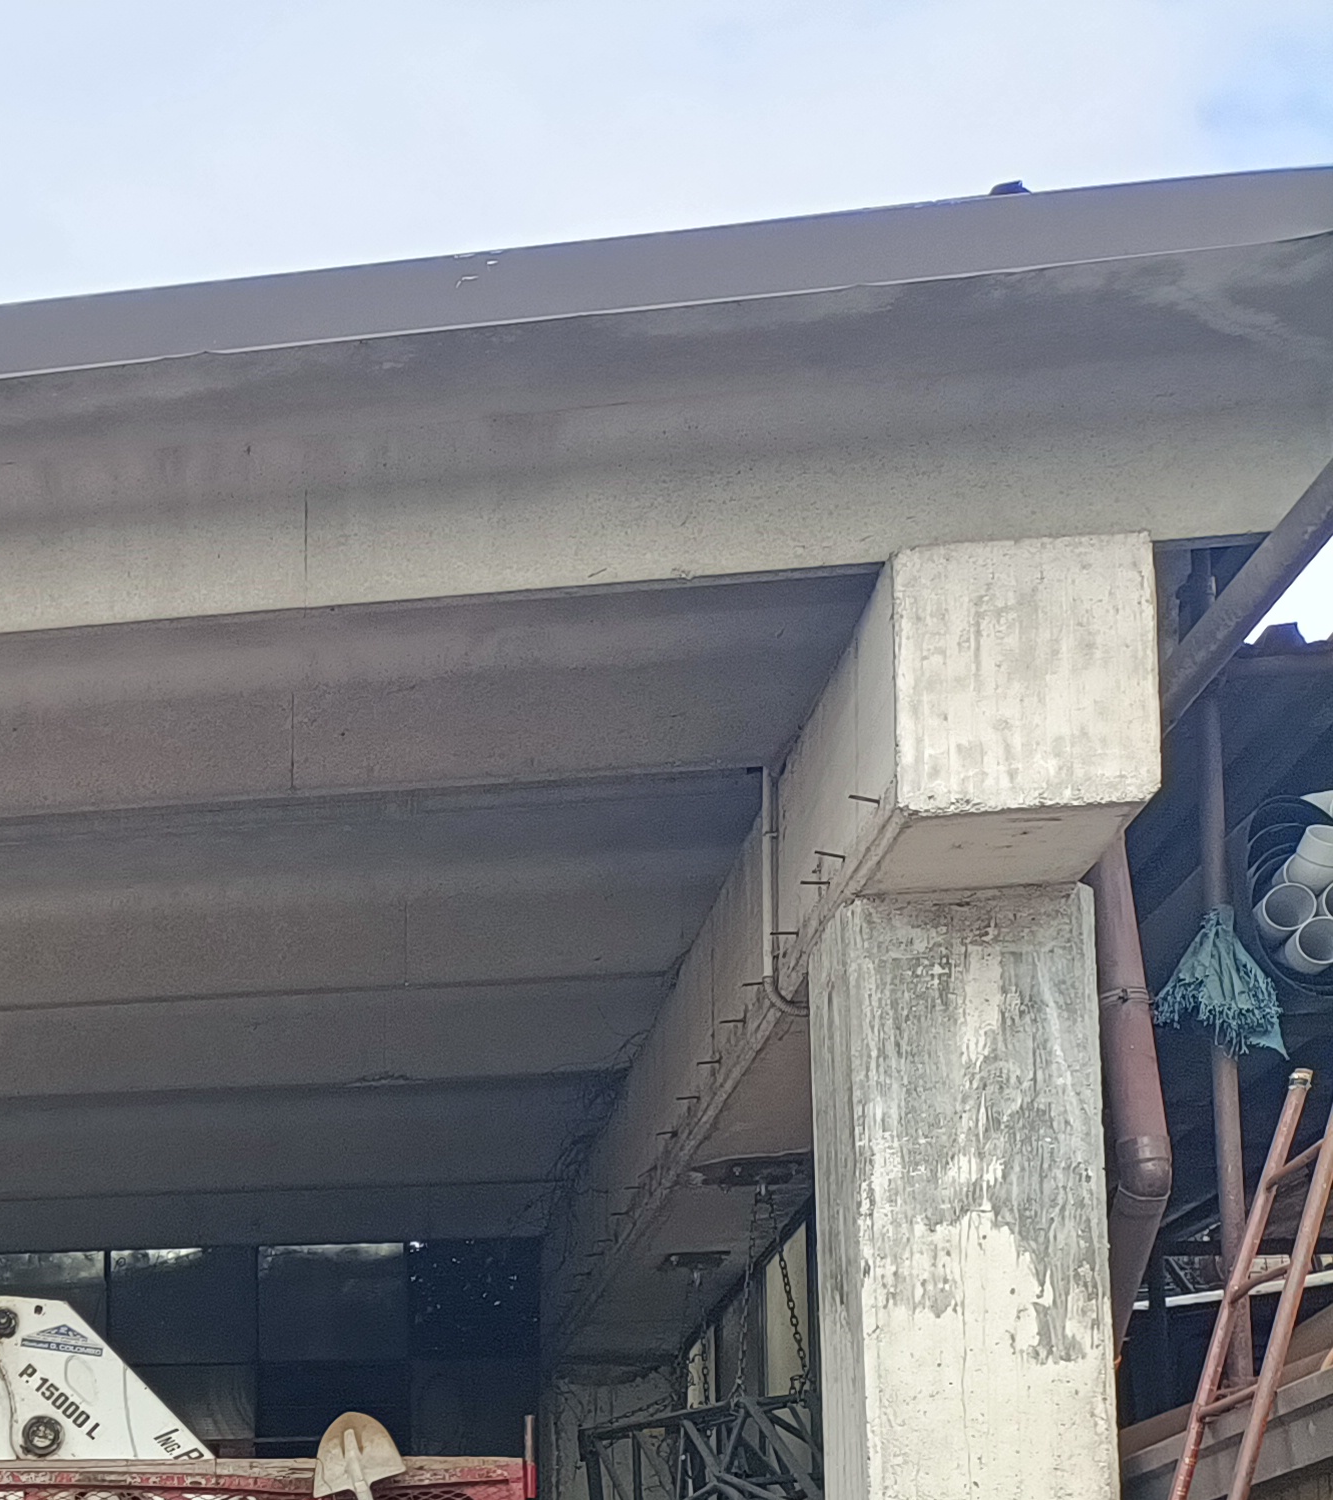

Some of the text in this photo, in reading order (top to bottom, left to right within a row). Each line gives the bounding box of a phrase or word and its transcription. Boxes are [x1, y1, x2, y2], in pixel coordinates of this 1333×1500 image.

[18, 1363, 101, 1440] P. 15000 L
